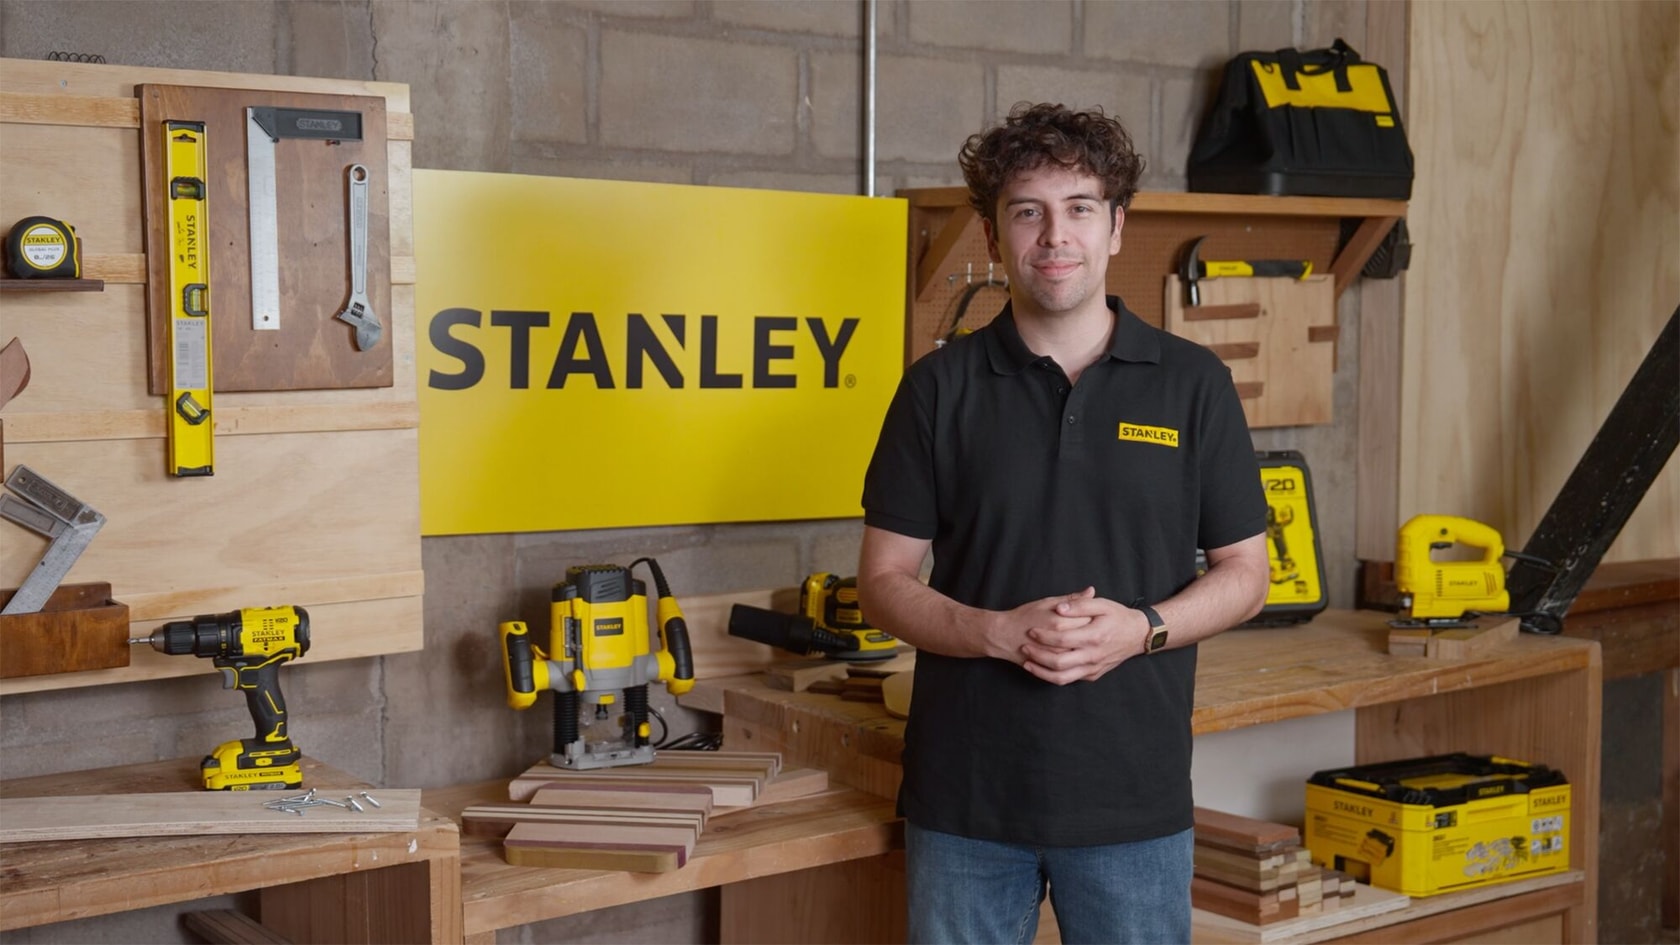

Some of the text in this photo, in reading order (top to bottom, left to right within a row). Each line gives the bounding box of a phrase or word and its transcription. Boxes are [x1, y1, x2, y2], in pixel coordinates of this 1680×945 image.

[186, 214, 196, 268] STANLEY
[428, 308, 861, 391] STANLEY
[224, 772, 258, 780] STANLEY
[1333, 800, 1374, 817] STANLEY
[1533, 794, 1567, 808] STANLEY
